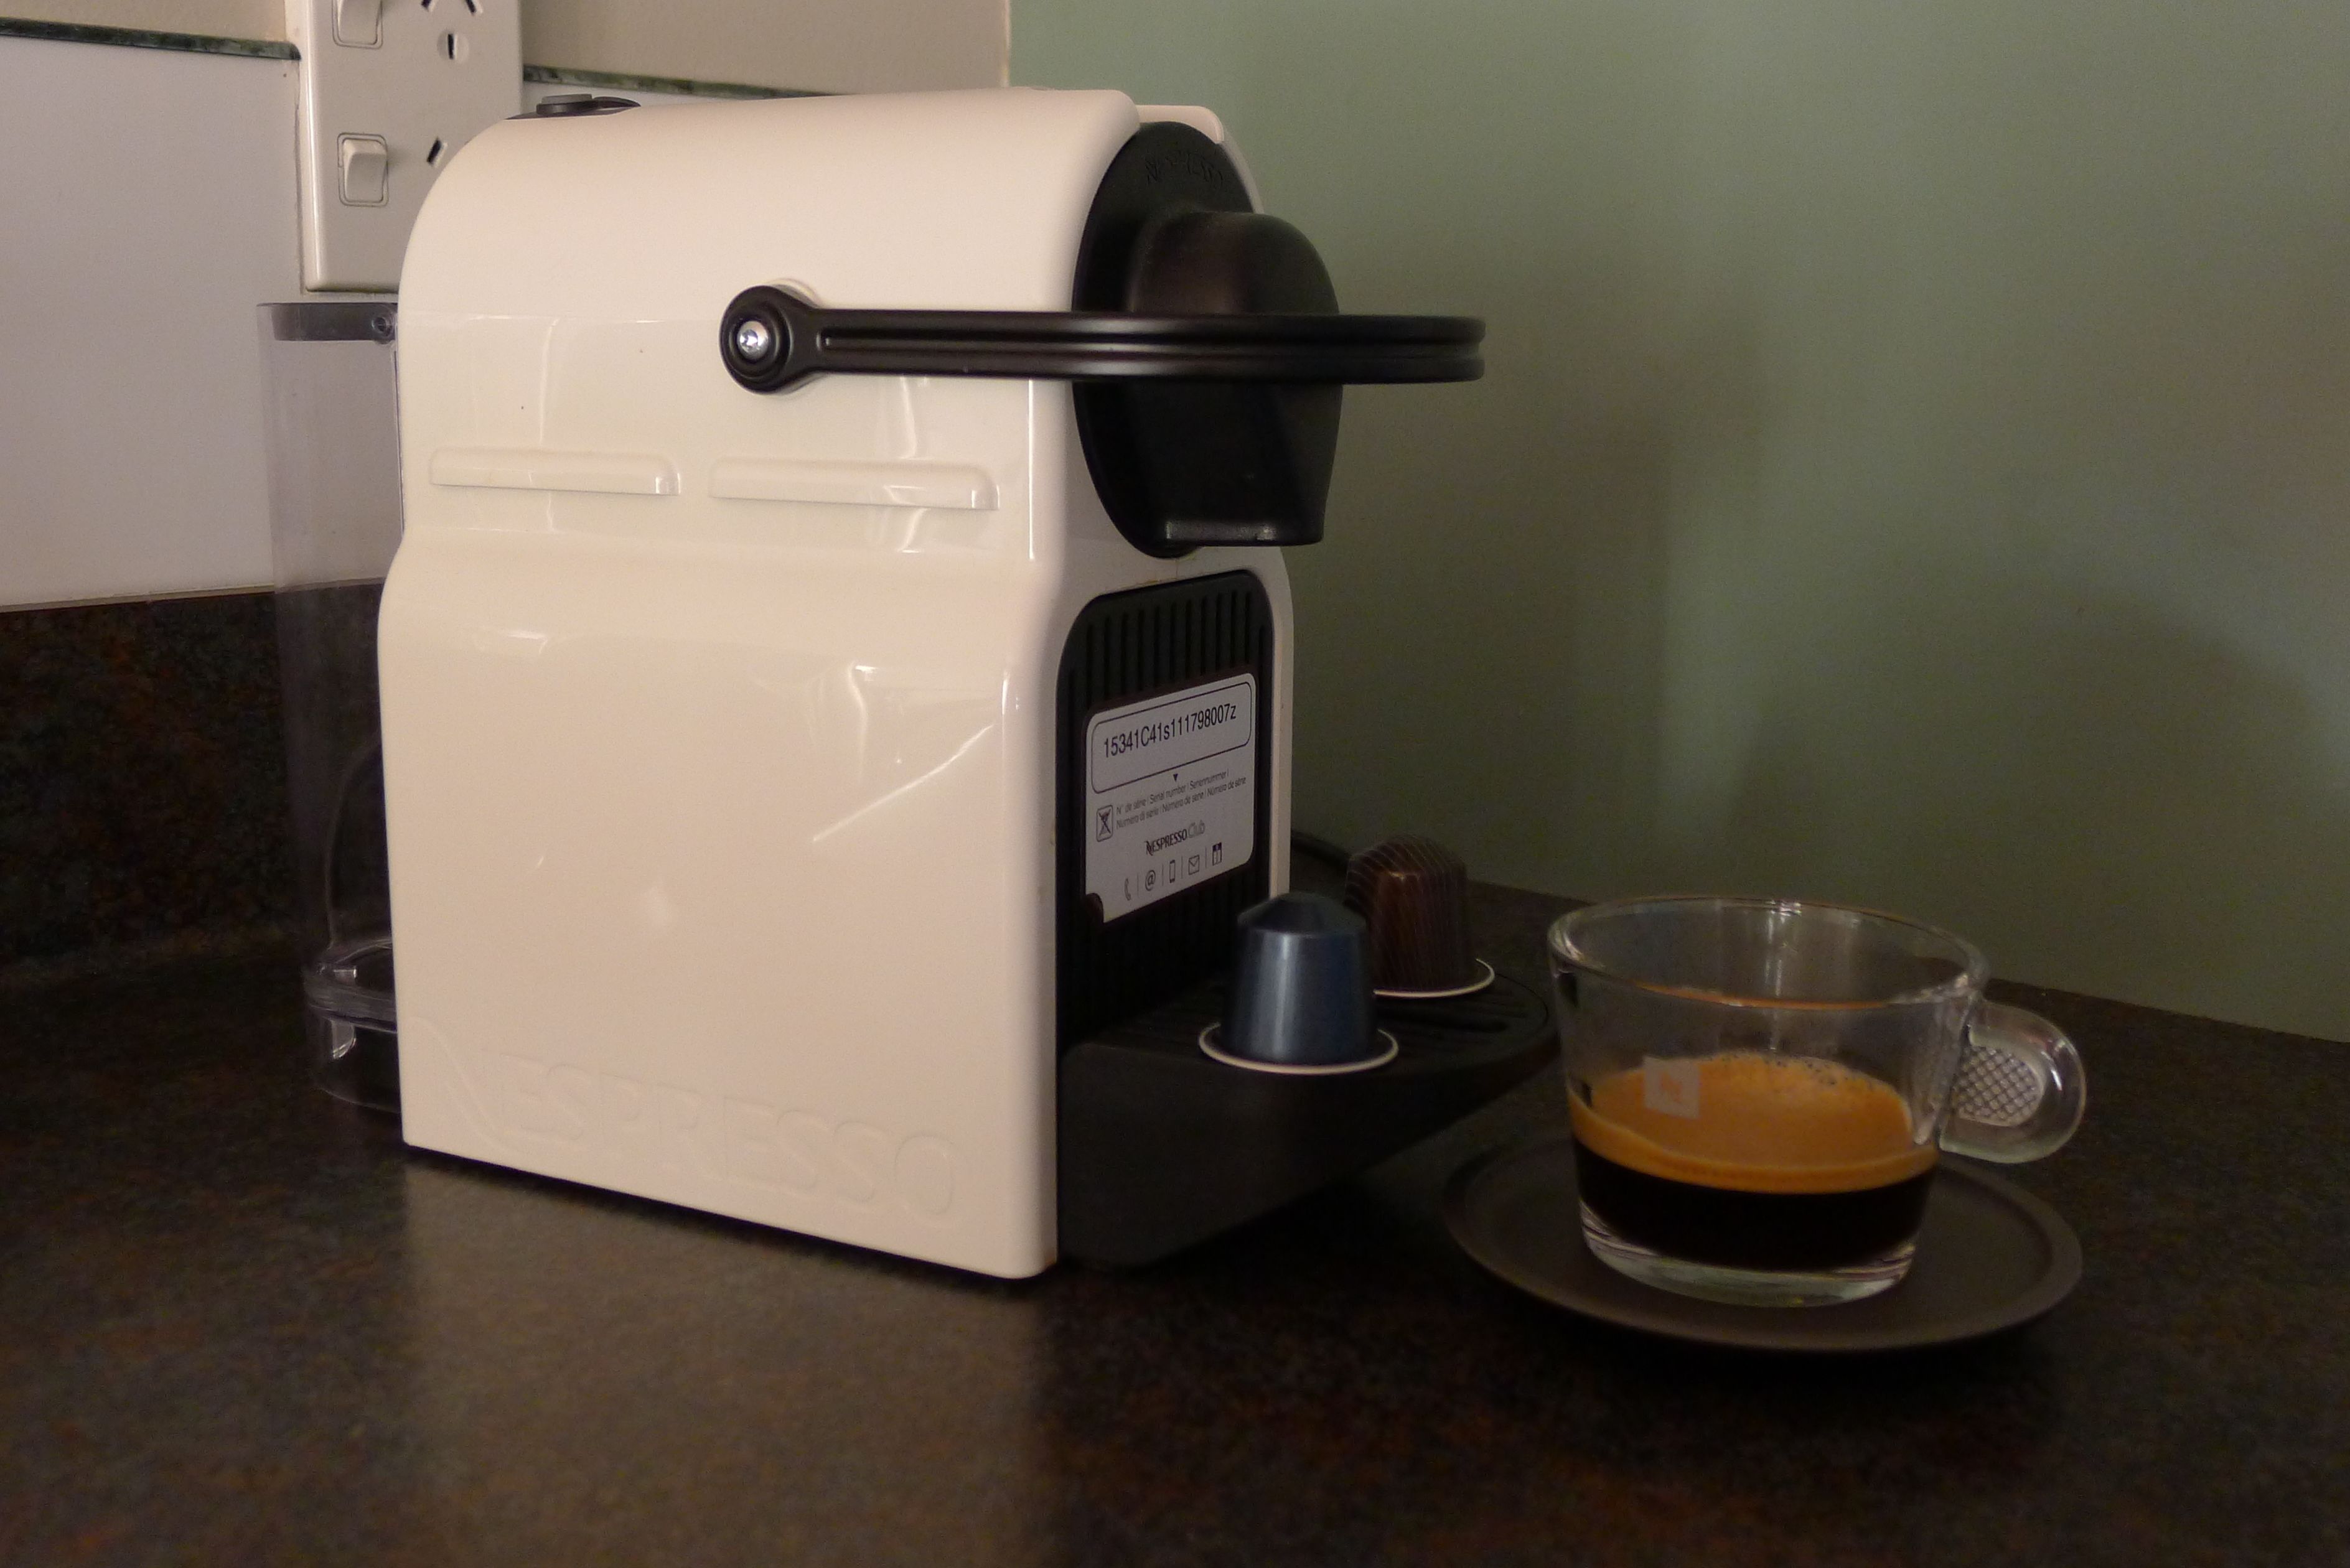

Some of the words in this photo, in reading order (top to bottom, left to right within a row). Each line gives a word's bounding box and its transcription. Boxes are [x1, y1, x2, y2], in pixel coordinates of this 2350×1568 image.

[1105, 704, 1236, 758] 15341C41s111798007z
[1144, 829, 1187, 856] NESPRESSO
[1188, 819, 1205, 838] Club
